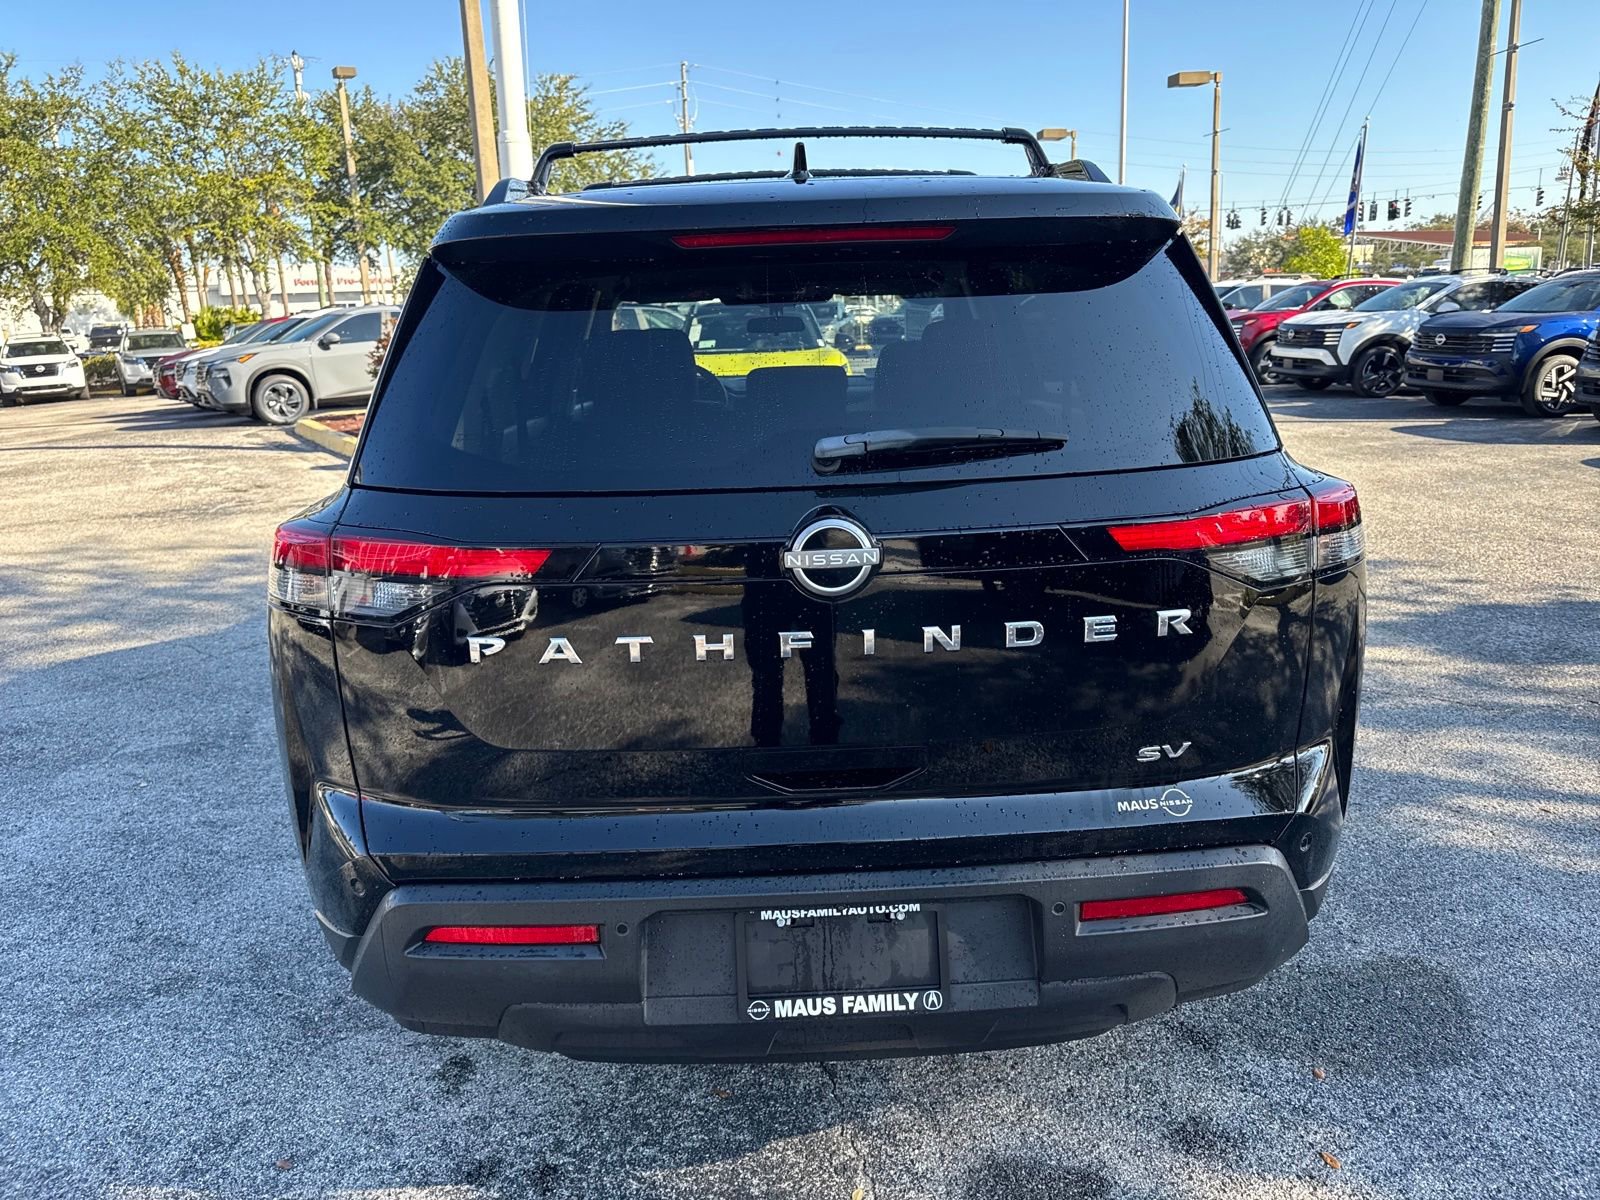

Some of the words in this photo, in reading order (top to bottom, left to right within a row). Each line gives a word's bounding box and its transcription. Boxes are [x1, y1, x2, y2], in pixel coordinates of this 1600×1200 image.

[787, 551, 877, 566] NISSAN
[467, 608, 1193, 664] PATHFINDER
[1136, 741, 1192, 763] SV
[1117, 798, 1159, 812] MAUS
[1160, 798, 1193, 806] NISSAN
[774, 996, 837, 1018] MAUS
[842, 992, 919, 1014] FAMILY
